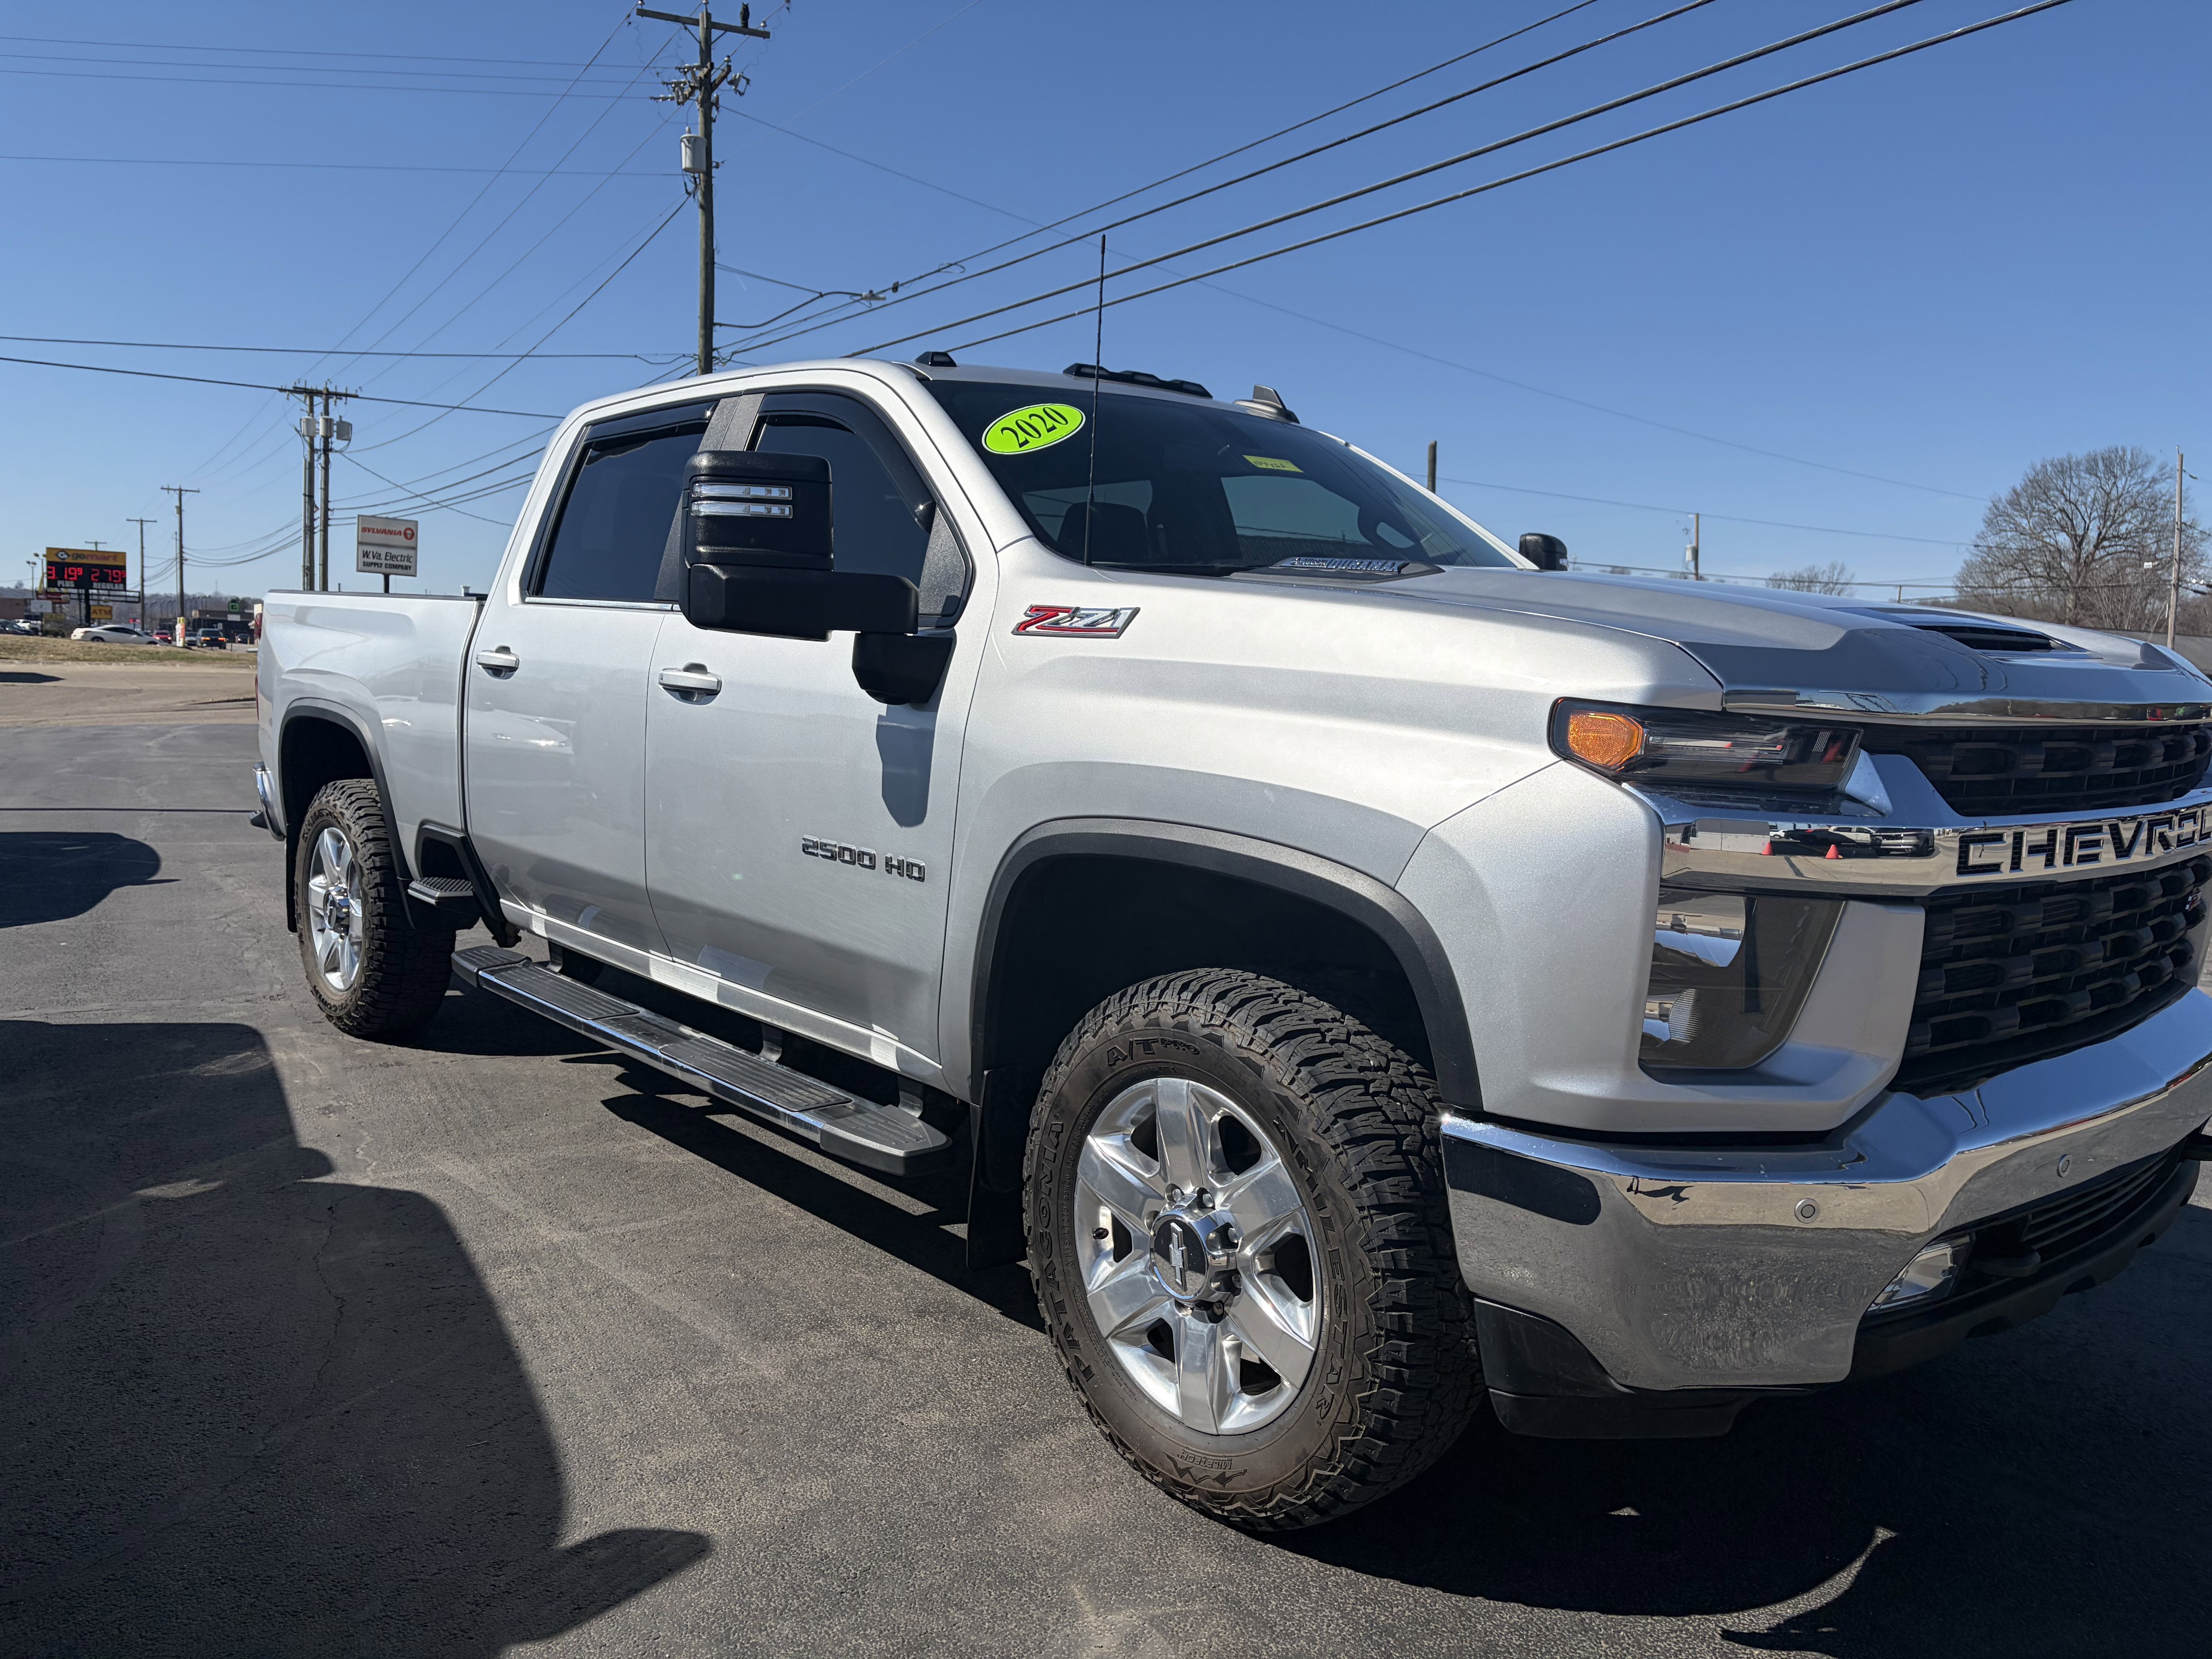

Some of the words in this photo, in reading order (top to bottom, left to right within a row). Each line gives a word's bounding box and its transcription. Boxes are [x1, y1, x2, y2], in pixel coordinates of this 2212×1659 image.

[1000, 407, 1068, 448] 2020
[361, 527, 402, 536] SYLVANIA
[385, 552, 413, 563] Electric
[1011, 604, 1141, 639] Z71
[802, 834, 876, 871] 2500
[885, 853, 926, 883] HD
[1106, 1036, 1159, 1067] A/T
[1160, 1037, 1200, 1055] PRO
[1039, 1121, 1096, 1382] PATAGONIA
[1181, 1451, 1232, 1470] MILETECH
